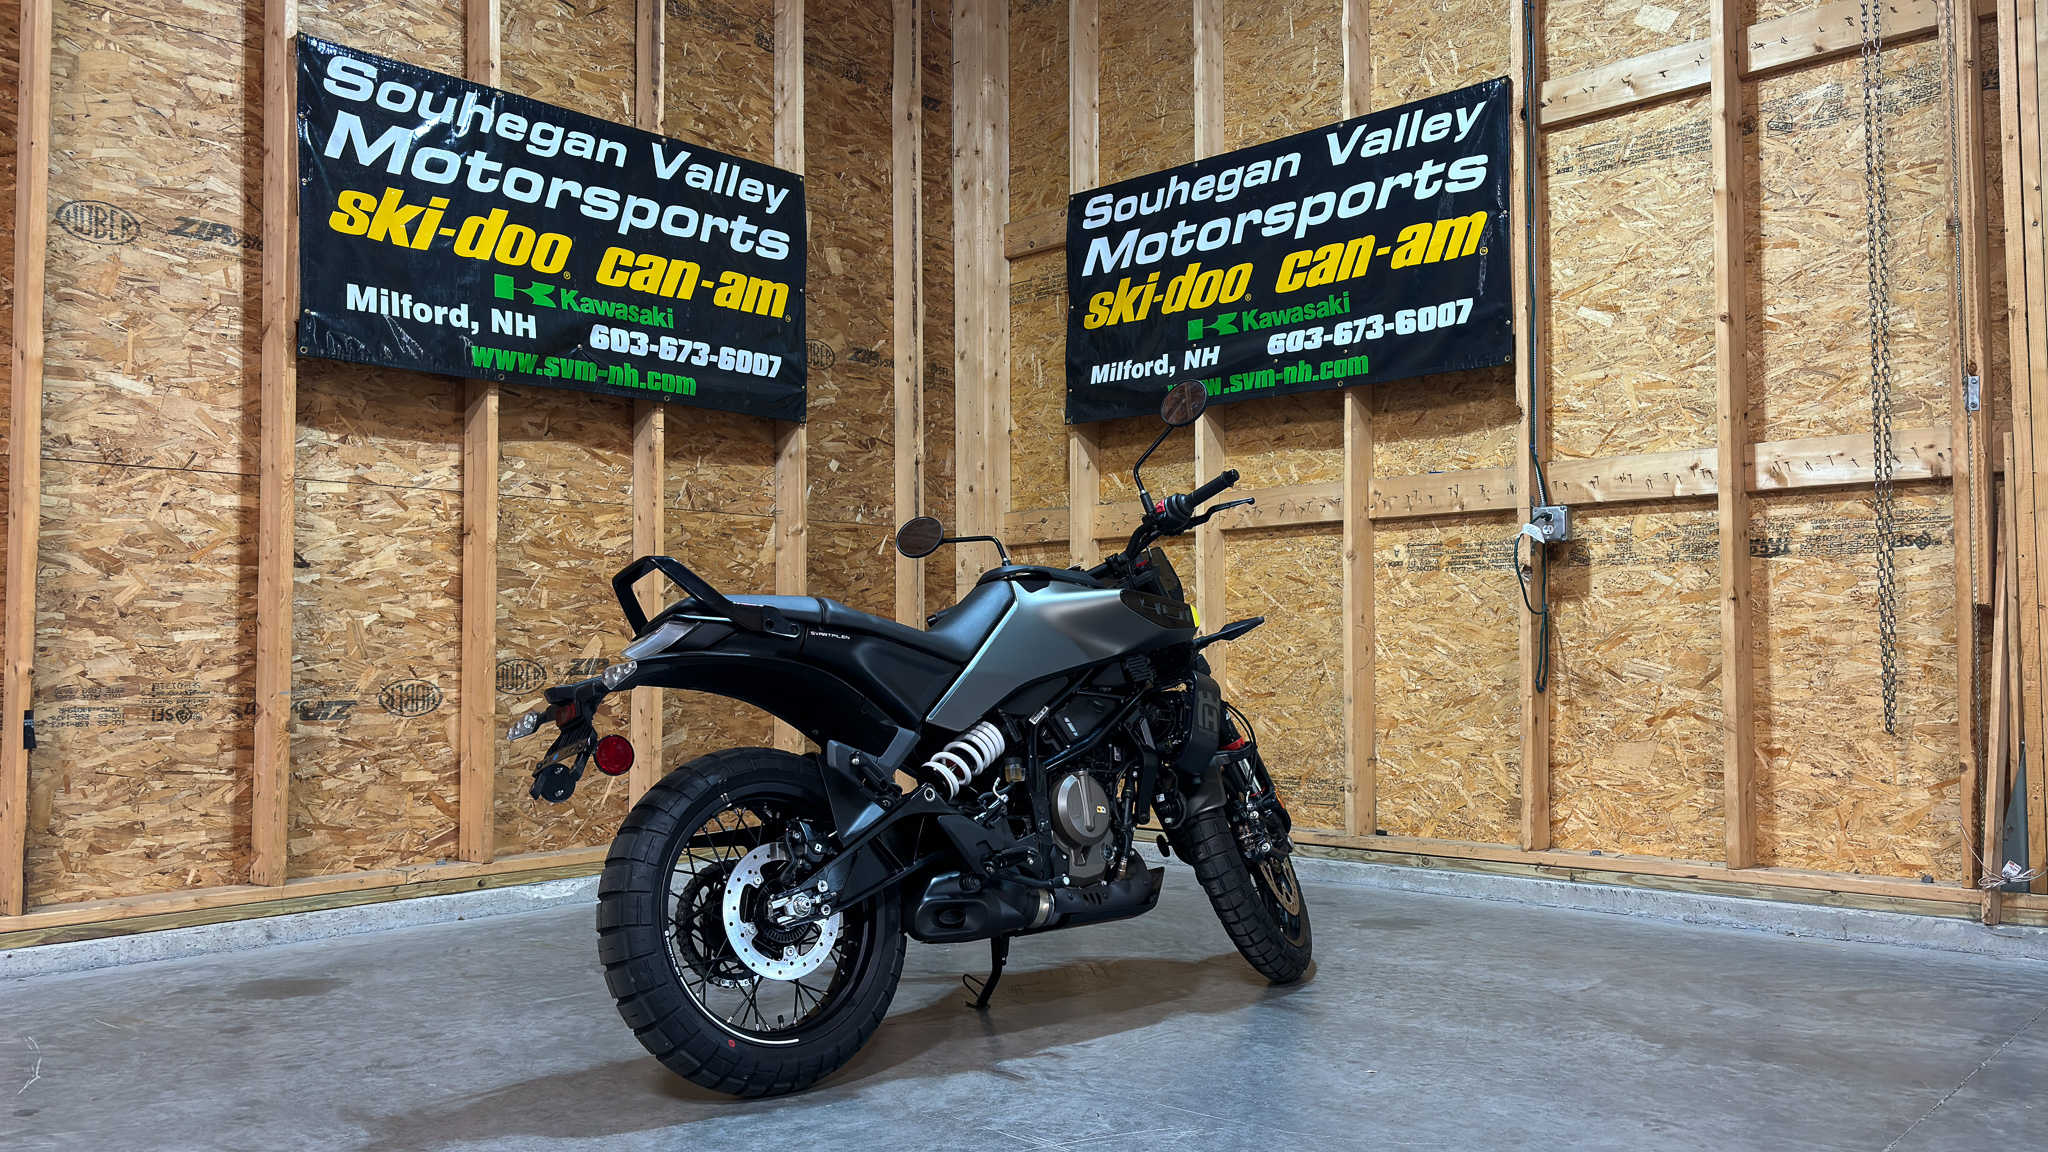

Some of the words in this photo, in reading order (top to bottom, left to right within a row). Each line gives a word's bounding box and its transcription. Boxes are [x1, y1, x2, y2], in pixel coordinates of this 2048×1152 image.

[323, 55, 627, 167] Souhegan
[651, 142, 790, 214] Valley
[324, 110, 791, 260] Motorsports
[1083, 153, 1302, 230] Souhegan
[1326, 100, 1488, 166] Valley
[1082, 154, 1489, 277] Motorsports
[329, 187, 572, 273] ski-doo
[596, 246, 789, 318] can-am
[1083, 262, 1254, 330] ski-doo
[1274, 210, 1488, 294] can-am
[346, 283, 480, 336] Milford,
[491, 307, 537, 338] NH
[560, 287, 674, 329] Kawasaki
[1241, 290, 1351, 332] Kawasaki
[1266, 297, 1474, 356] 603-673-6007
[470, 345, 697, 396] www.svm-nh.com
[589, 323, 782, 378] 603-673-6007
[806, 342, 834, 368] UBER
[1090, 353, 1176, 385] Milford,
[1183, 345, 1221, 371] NH
[1167, 354, 1369, 397] w.svm-nh.com
[810, 631, 851, 640] SVARTPILEN
